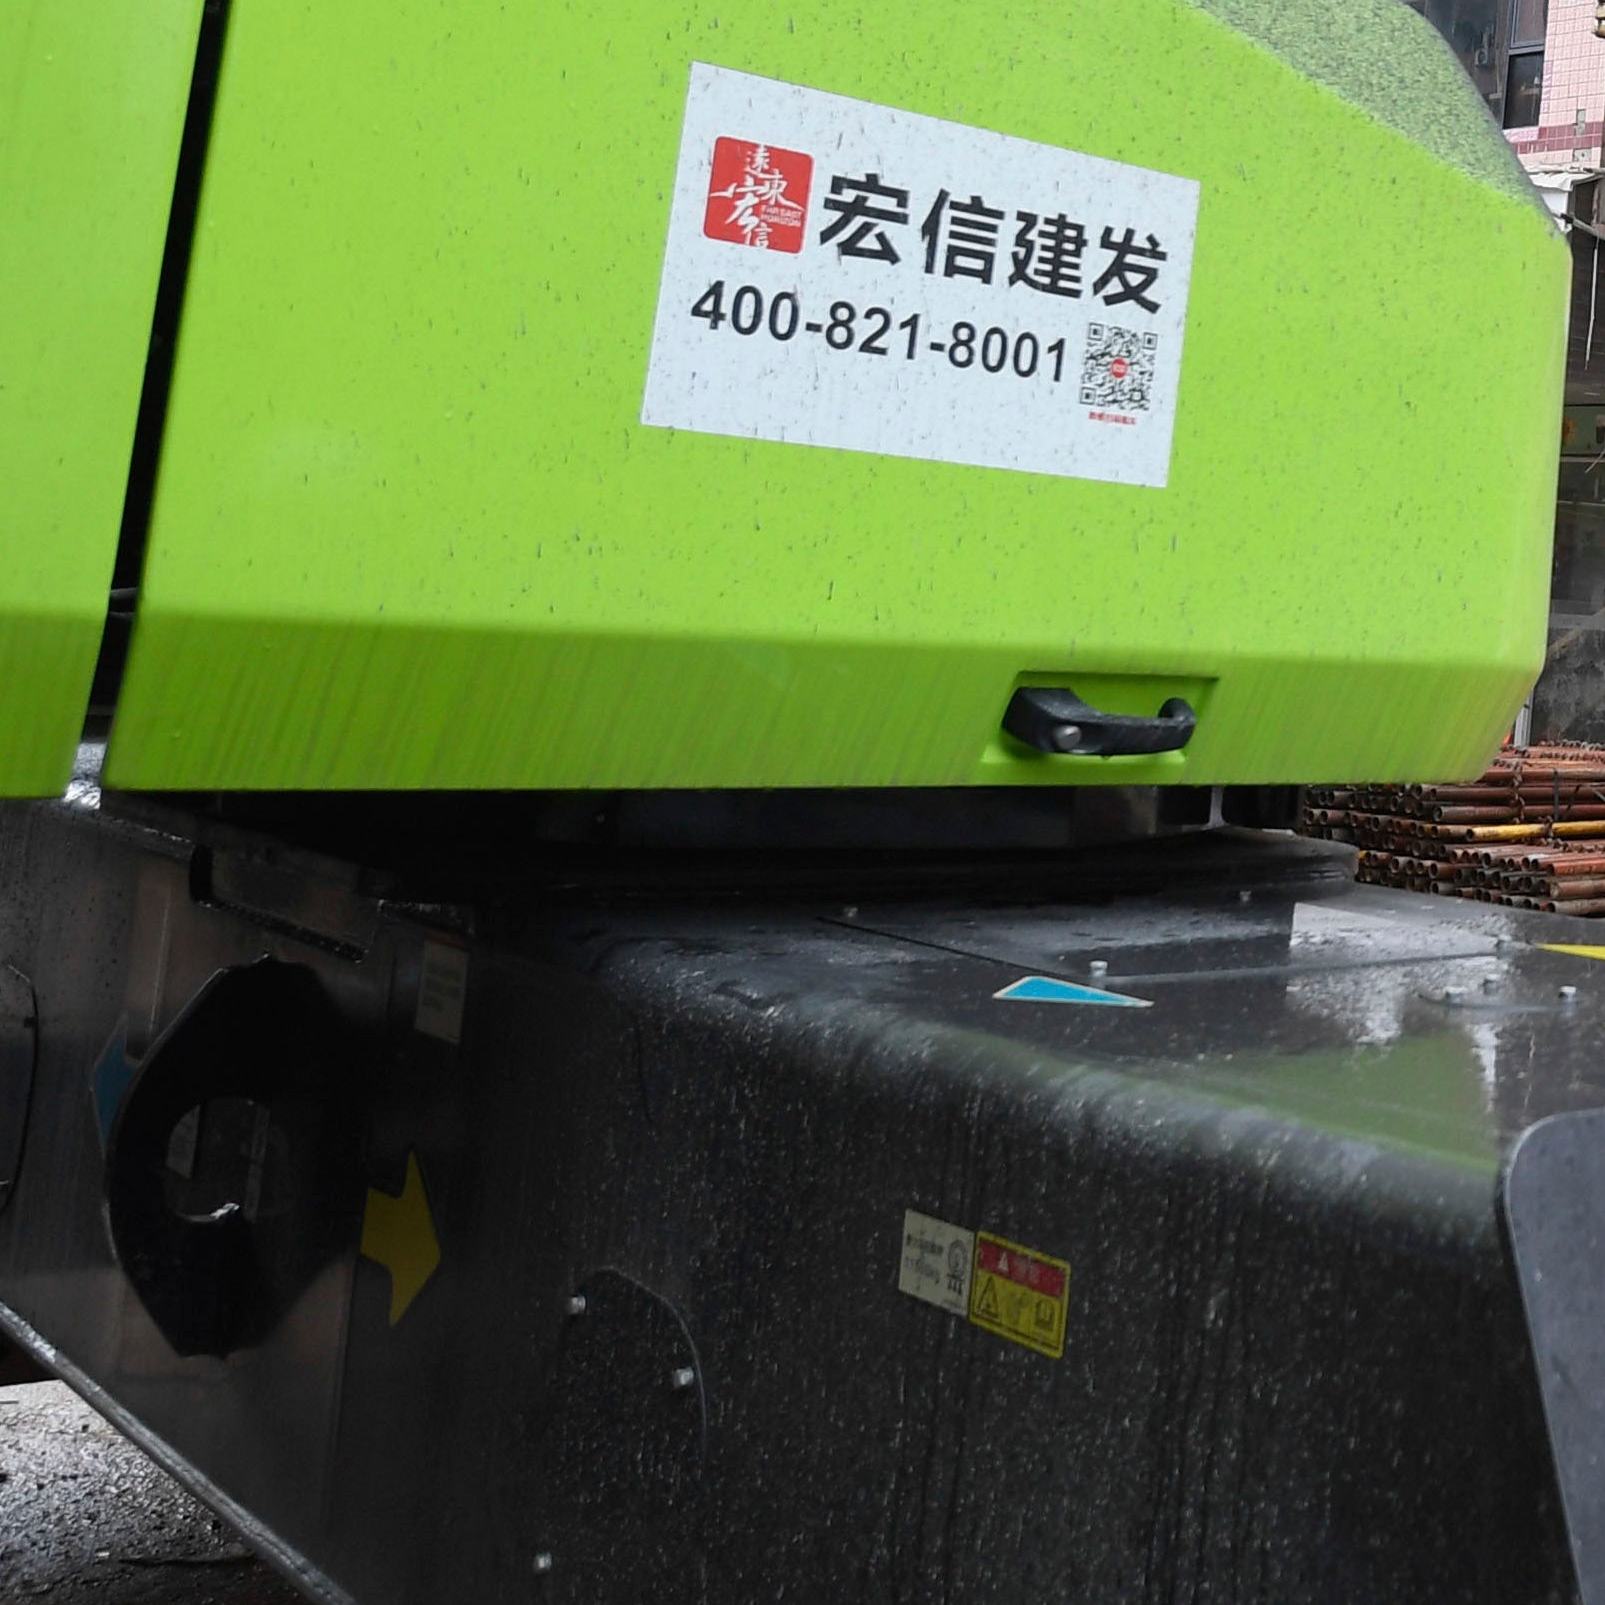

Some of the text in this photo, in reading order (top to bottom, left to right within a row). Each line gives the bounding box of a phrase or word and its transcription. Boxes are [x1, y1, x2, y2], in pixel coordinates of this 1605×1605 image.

[818, 172, 1167, 313] 宏信建发
[690, 280, 1067, 382] 400-821-8001
